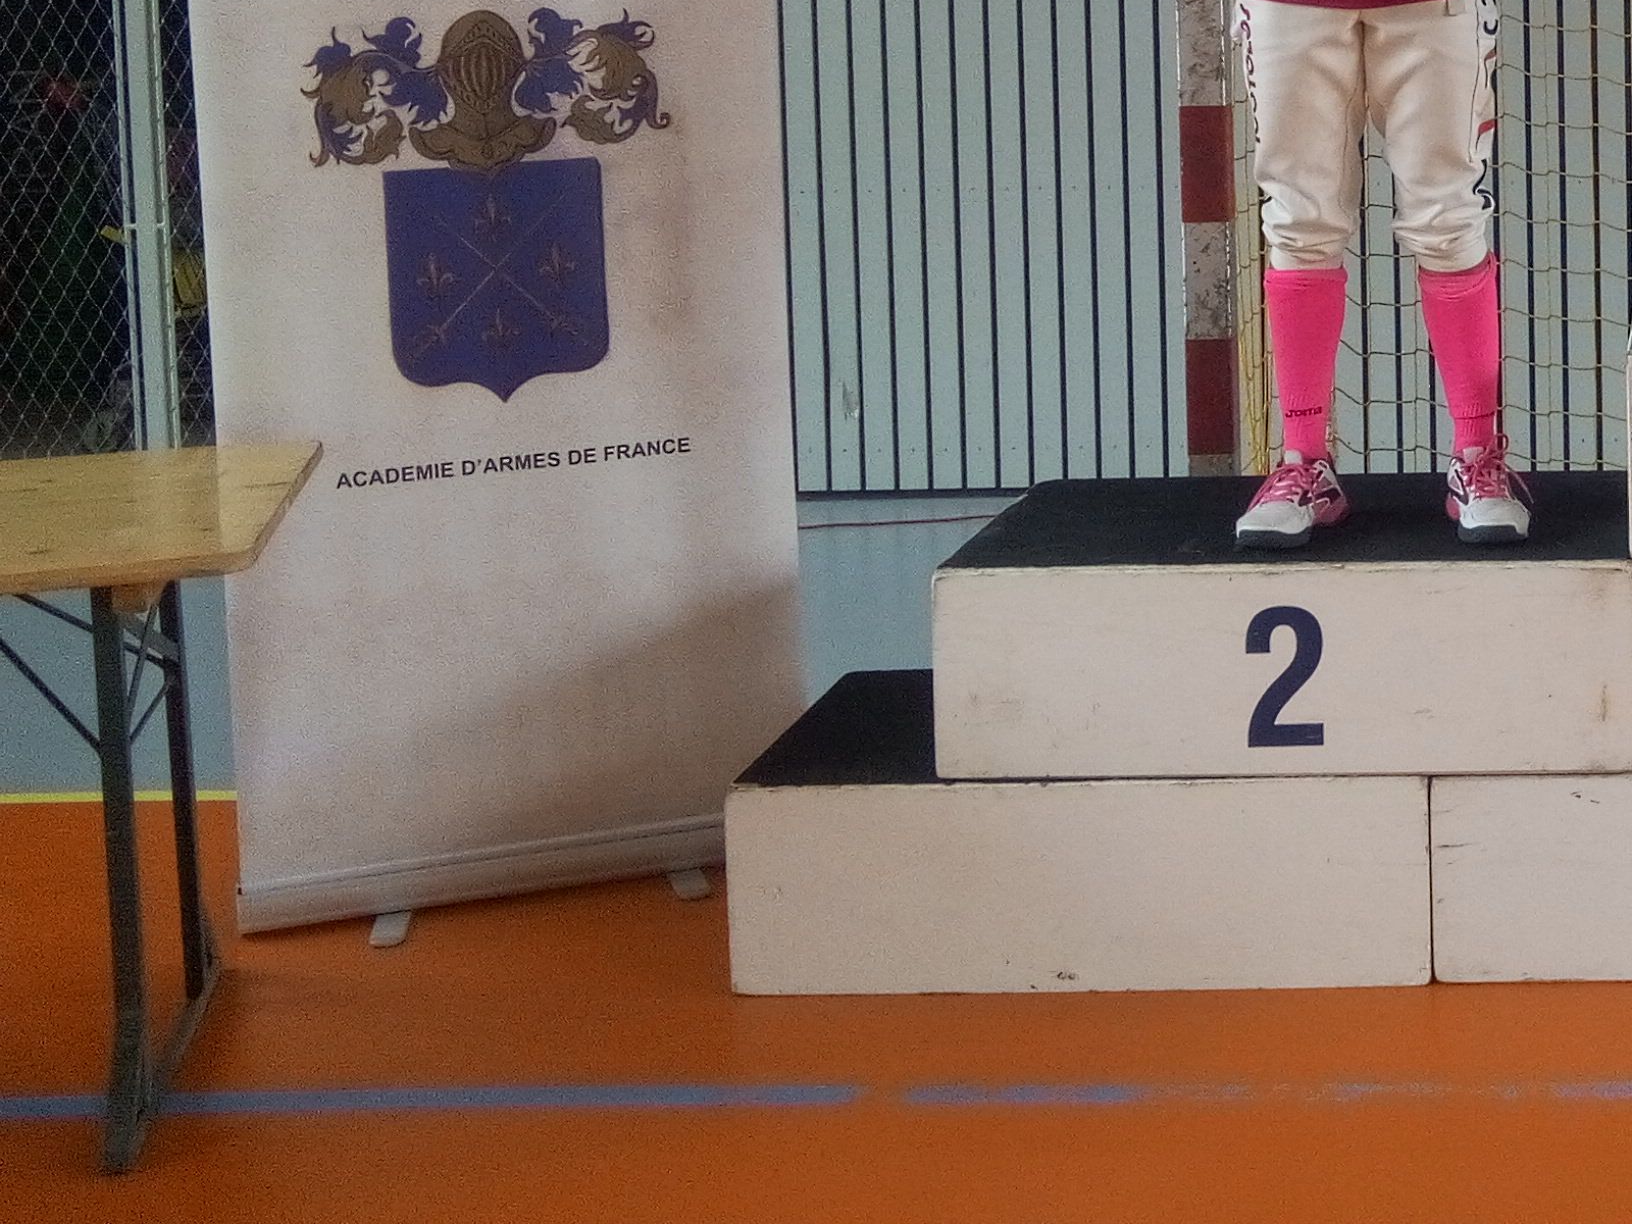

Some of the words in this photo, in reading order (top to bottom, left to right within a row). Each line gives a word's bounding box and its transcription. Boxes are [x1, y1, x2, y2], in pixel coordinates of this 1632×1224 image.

[336, 461, 455, 489] ACADEMIE
[462, 451, 561, 476] D'ARMES
[568, 447, 597, 466] DE
[603, 436, 692, 463] FRANCE
[1246, 606, 1324, 746] 2
